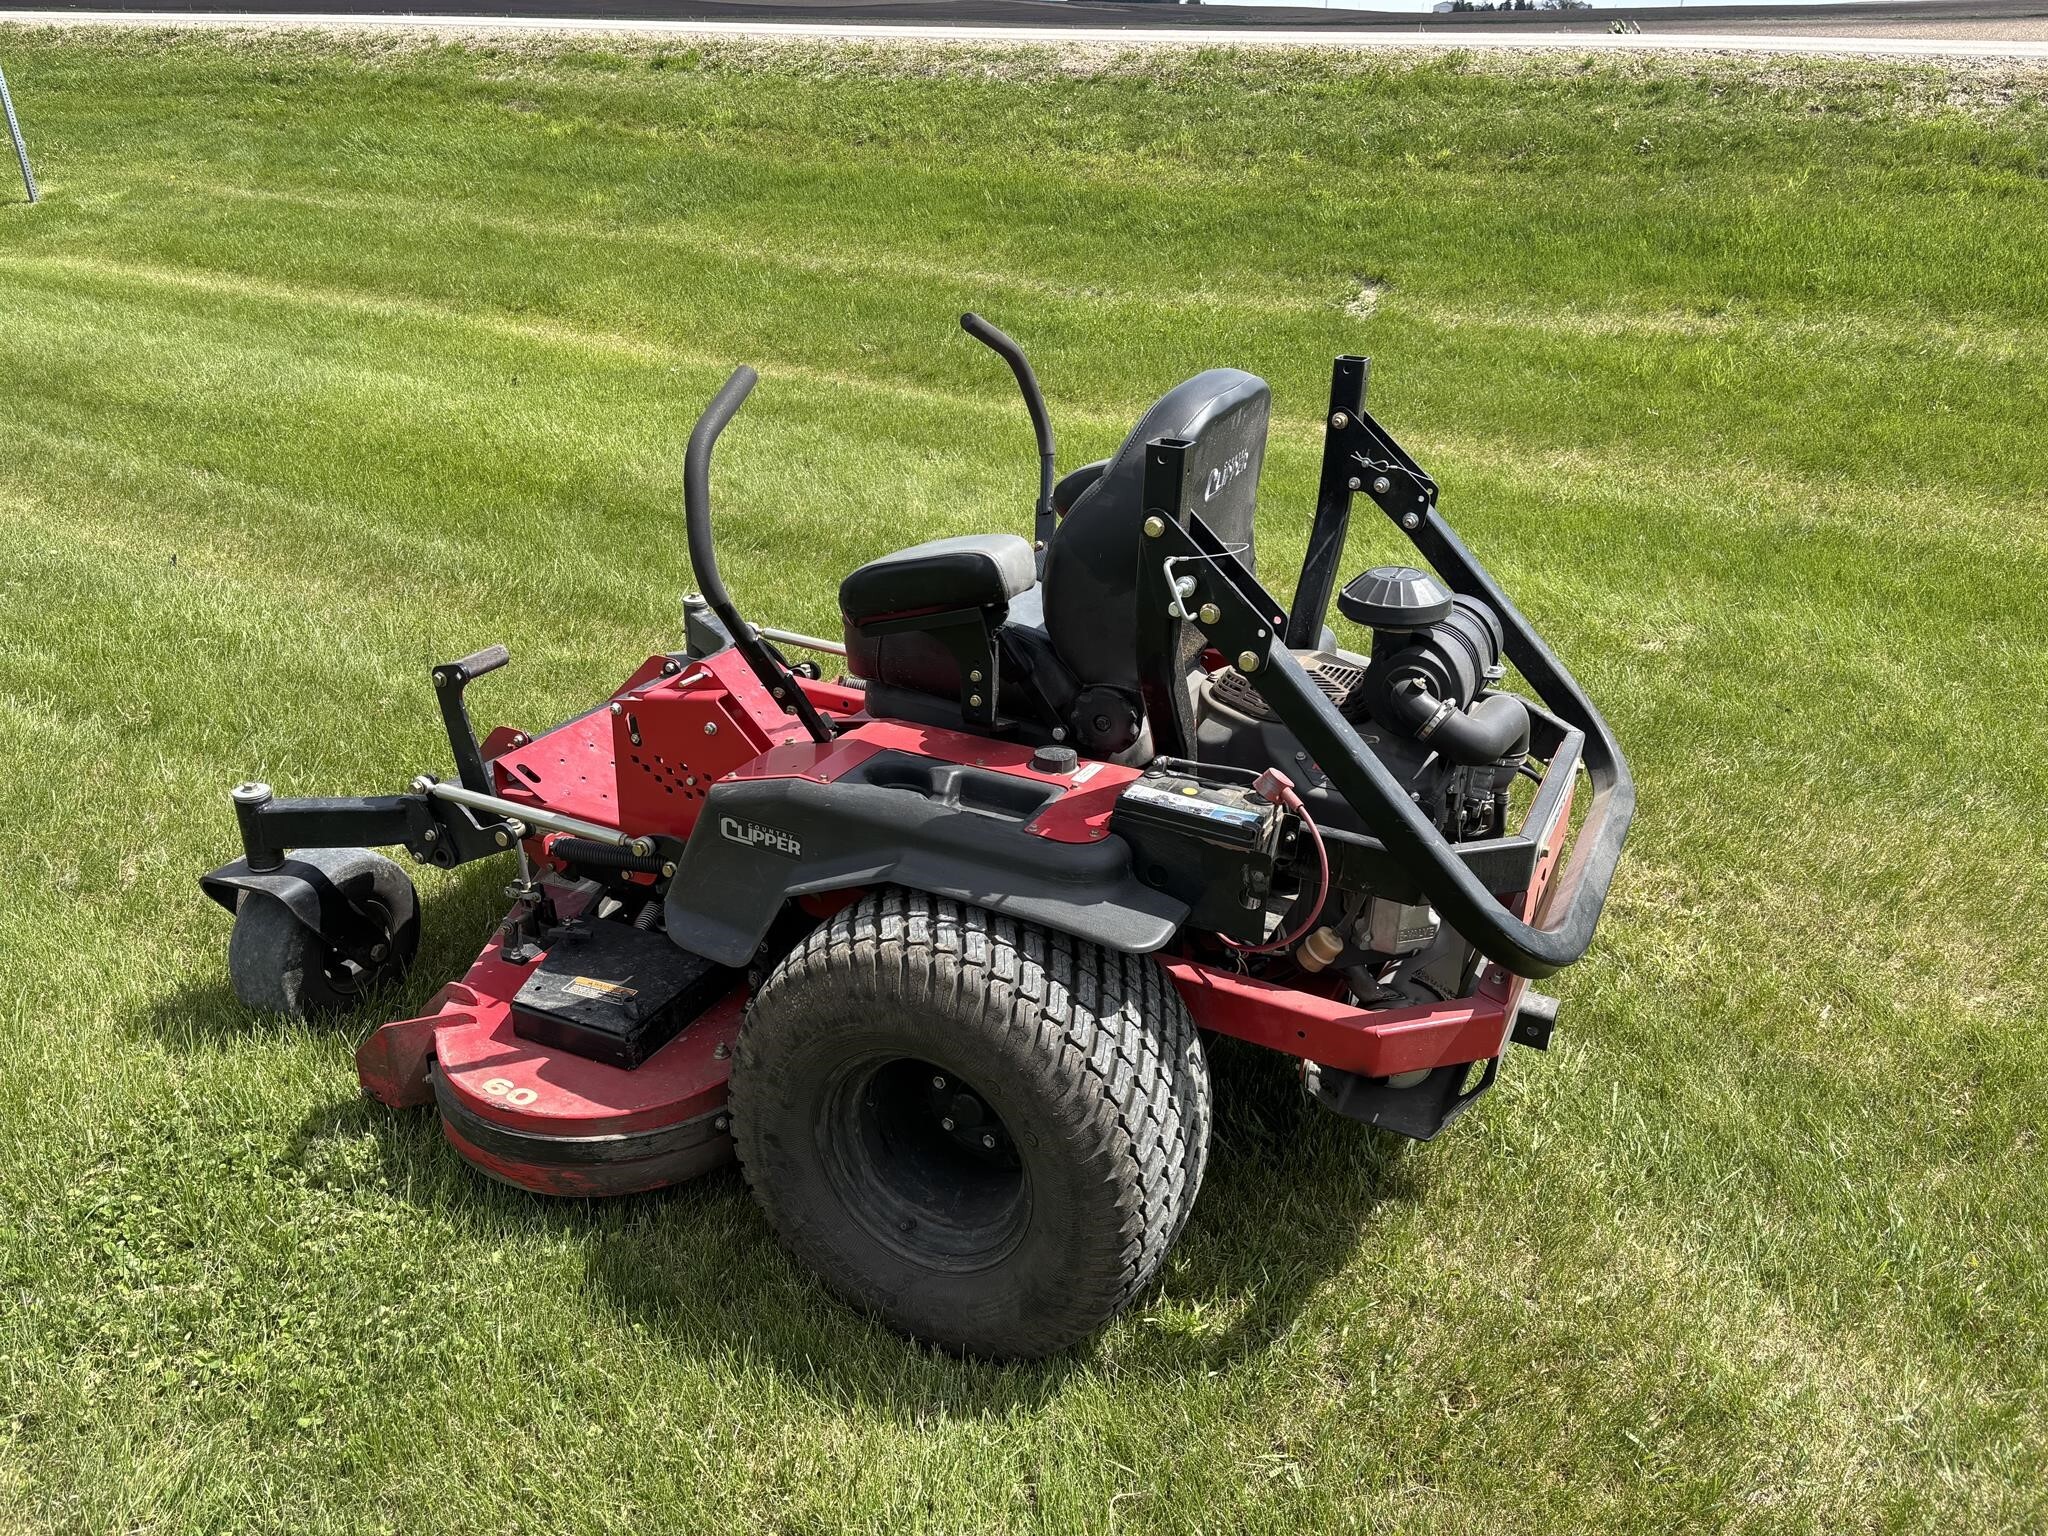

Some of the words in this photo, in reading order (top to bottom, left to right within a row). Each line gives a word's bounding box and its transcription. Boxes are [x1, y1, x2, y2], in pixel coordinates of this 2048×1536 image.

[720, 817, 801, 855] CLIPPER
[747, 822, 793, 839] COUNTRY
[481, 1077, 539, 1106] 60
